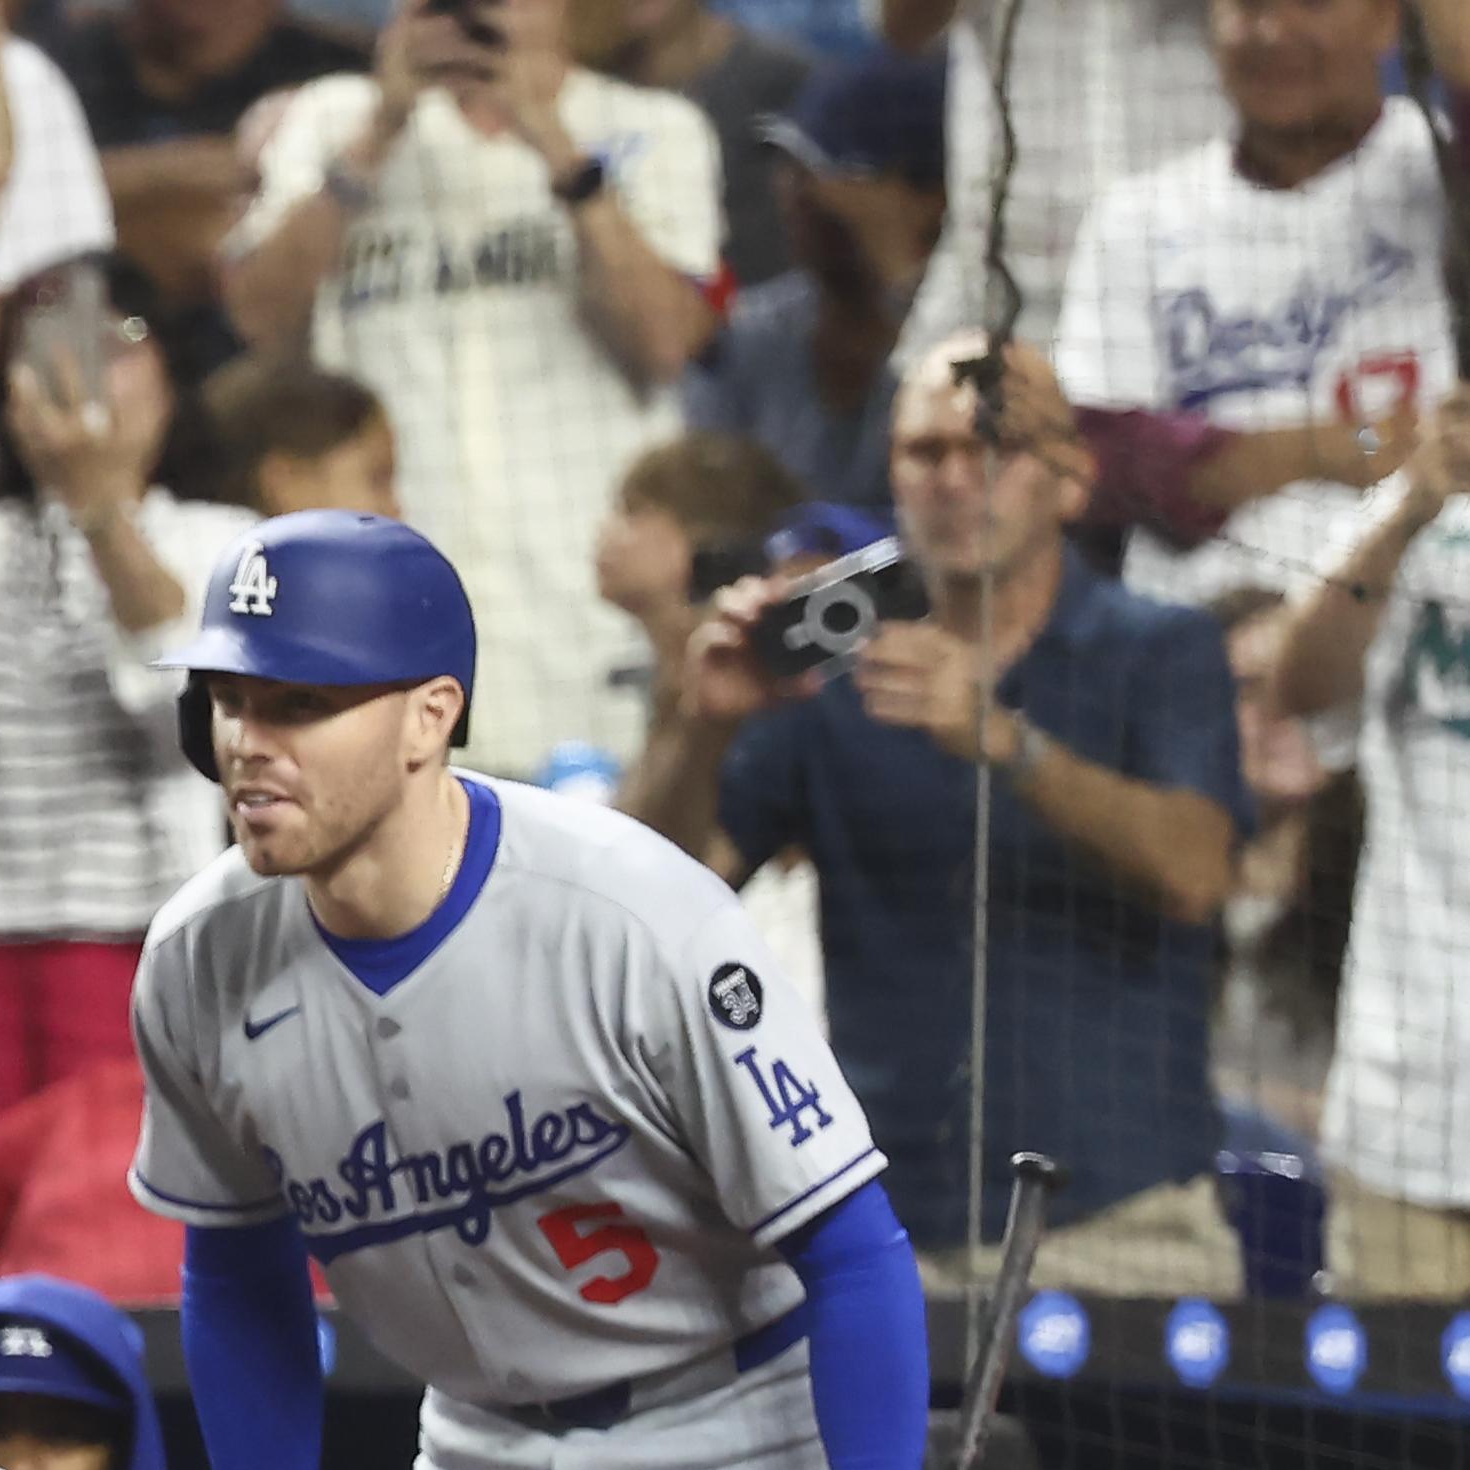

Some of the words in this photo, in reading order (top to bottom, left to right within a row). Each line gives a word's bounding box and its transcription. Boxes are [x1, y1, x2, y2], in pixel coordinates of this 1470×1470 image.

[228, 542, 278, 617] LA
[734, 1045, 834, 1147] LA
[338, 1089, 630, 1248] Angeles
[537, 1201, 658, 1307] 5
